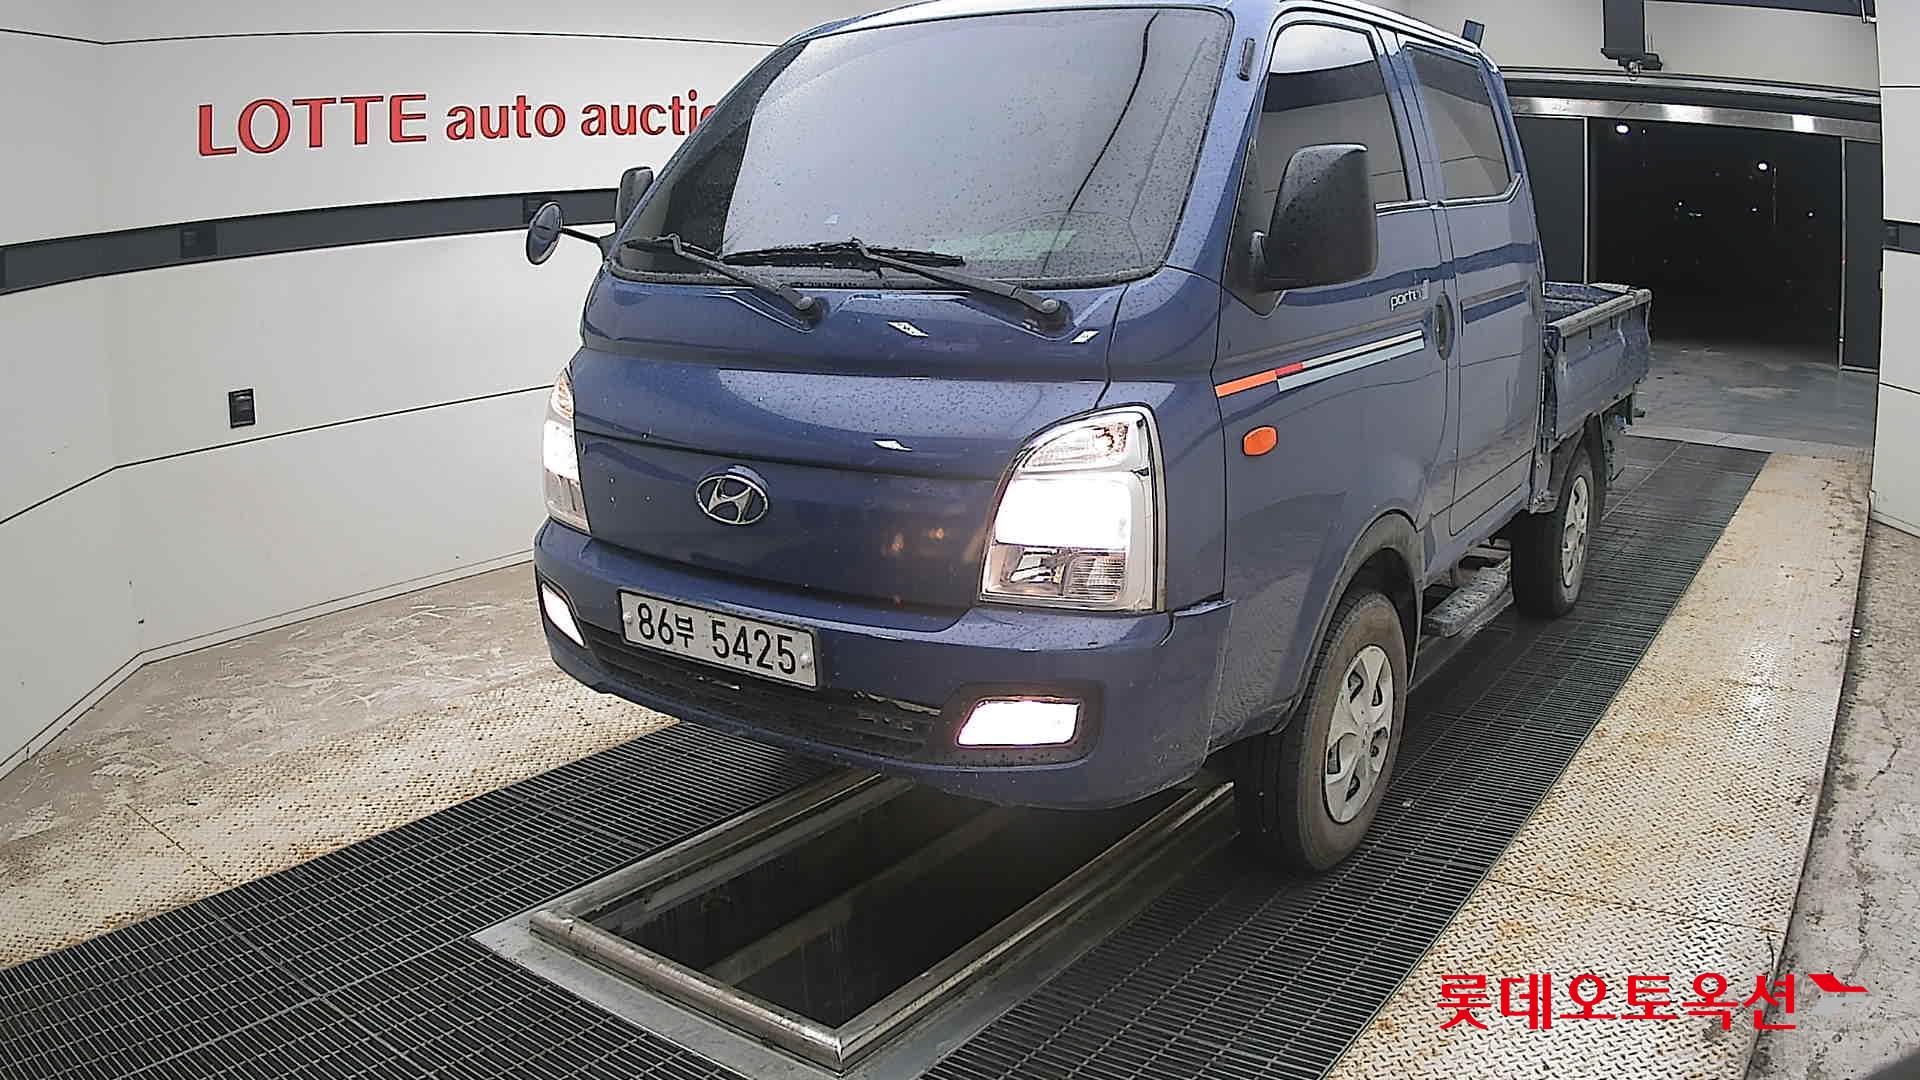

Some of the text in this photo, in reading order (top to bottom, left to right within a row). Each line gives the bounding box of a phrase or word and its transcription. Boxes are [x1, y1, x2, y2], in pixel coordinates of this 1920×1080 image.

[198, 93, 427, 156] LOTTE
[446, 95, 566, 140] auto
[637, 602, 796, 675] 86부 5425
